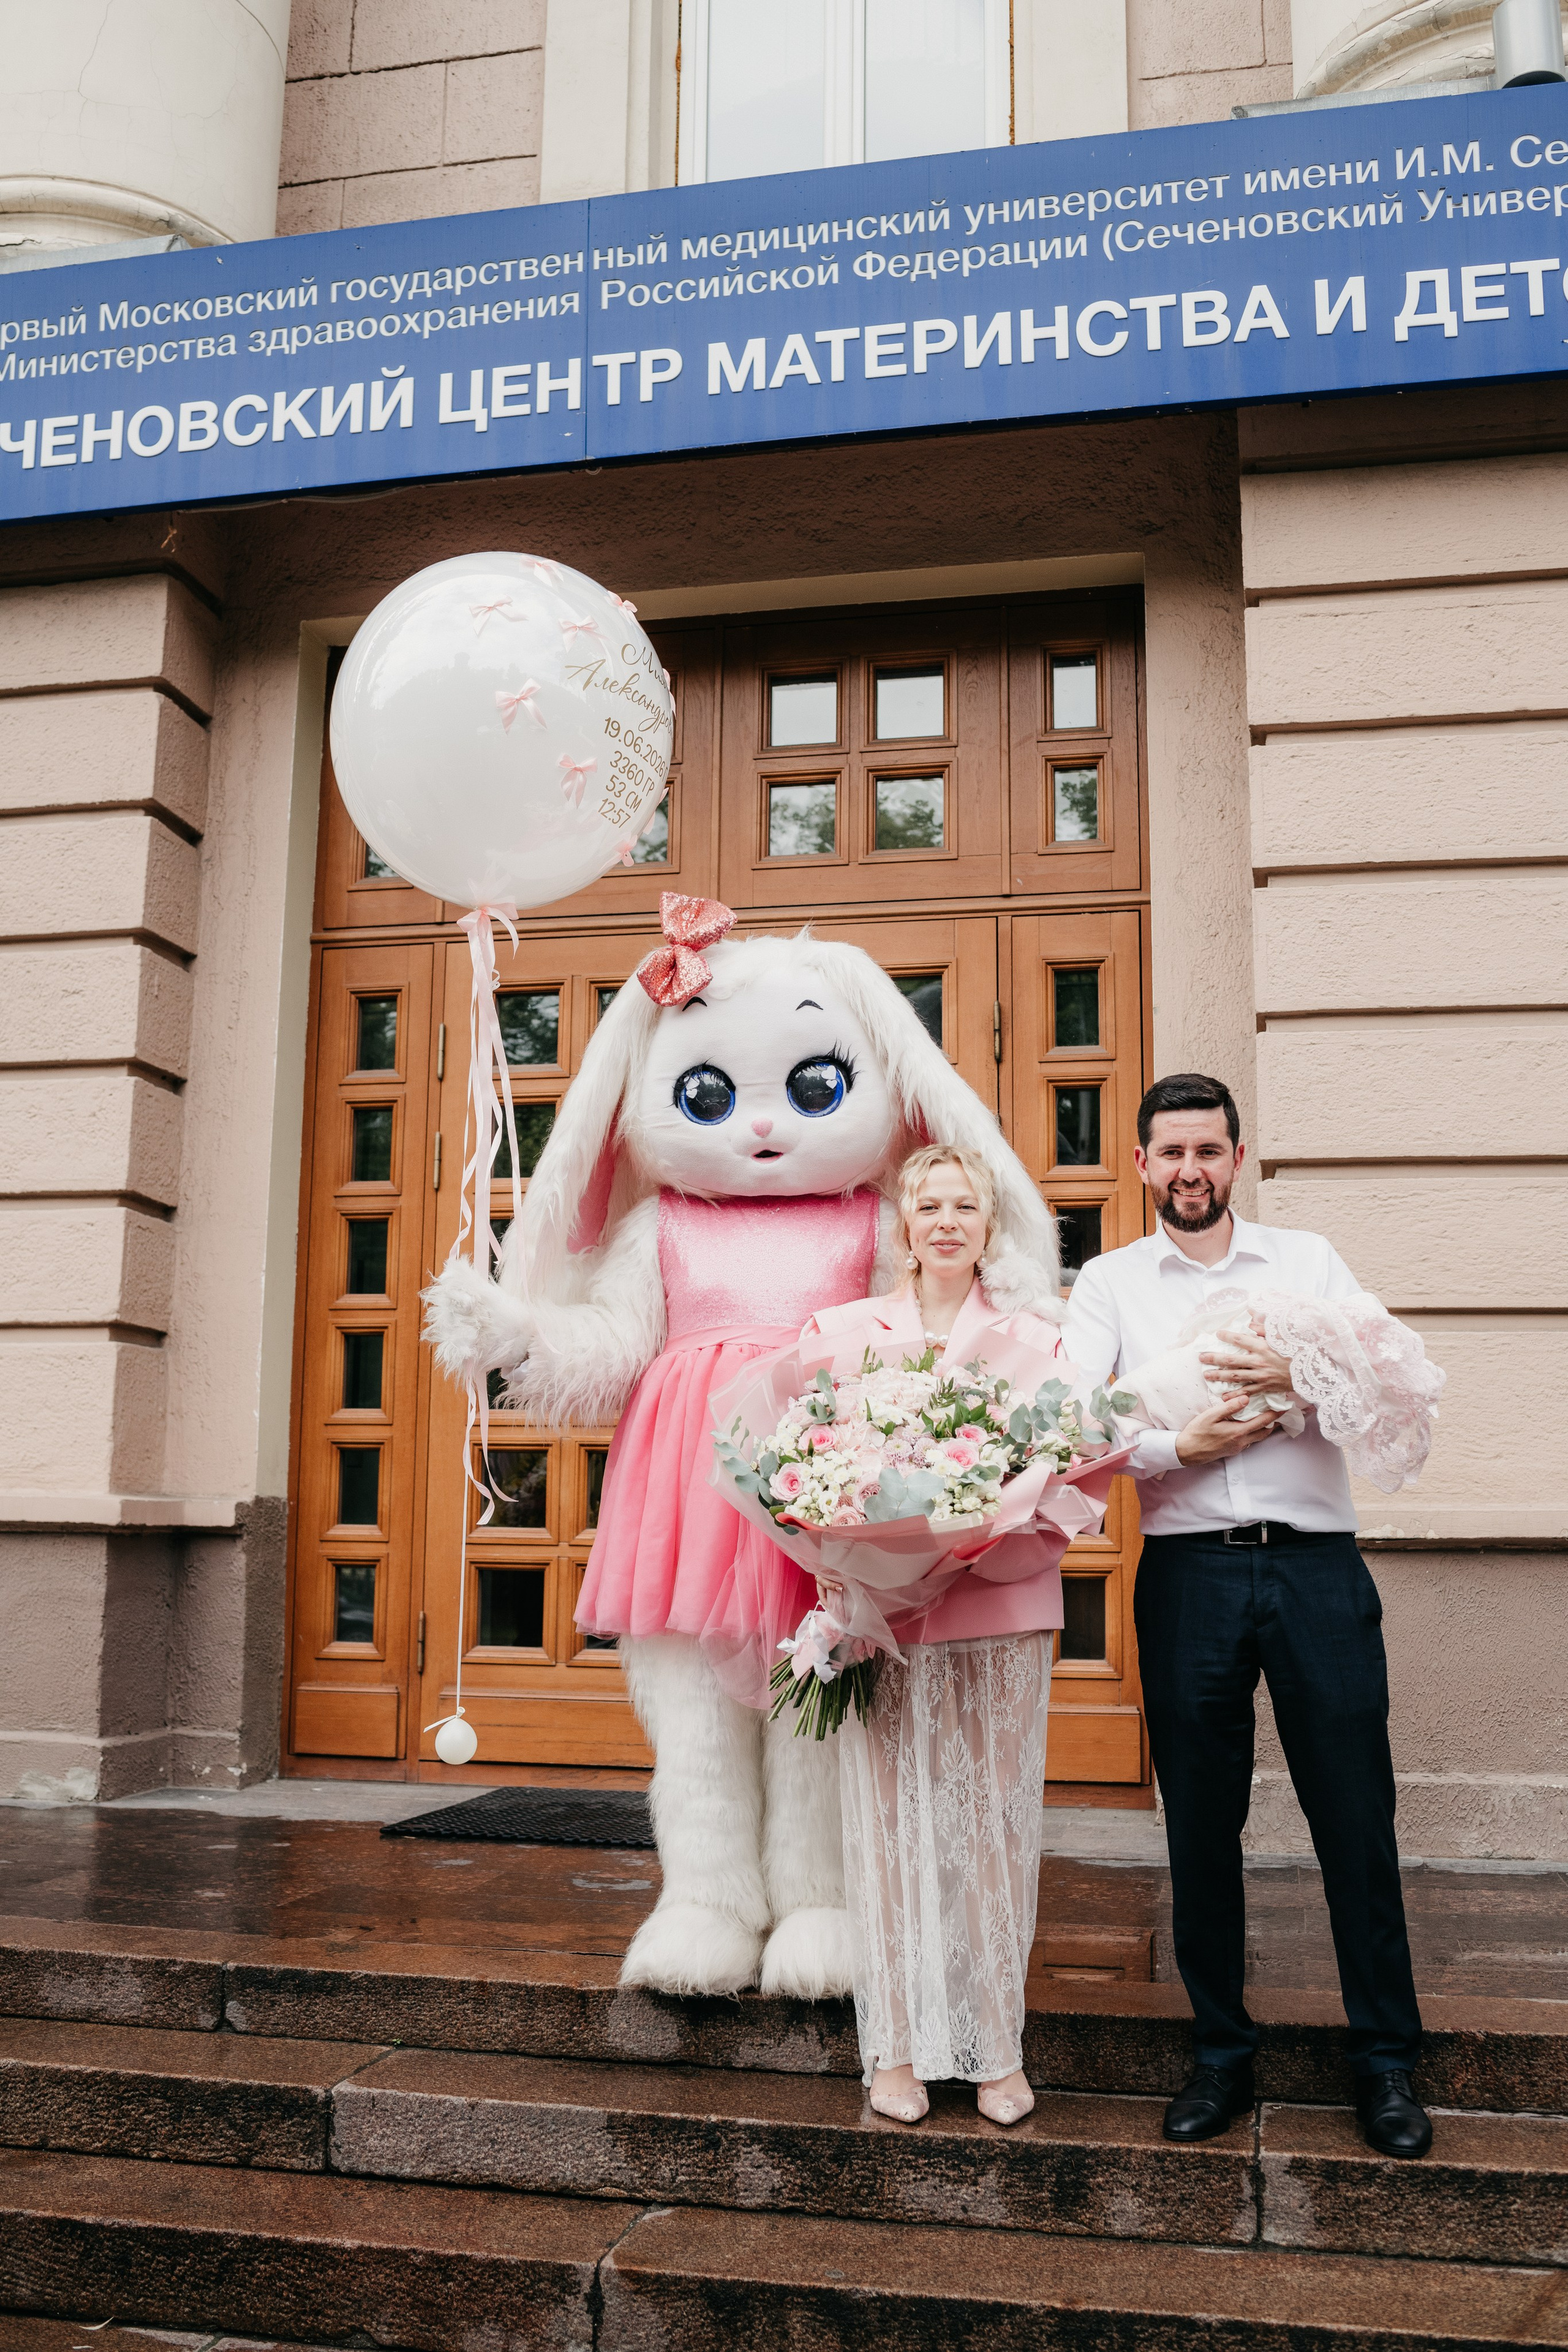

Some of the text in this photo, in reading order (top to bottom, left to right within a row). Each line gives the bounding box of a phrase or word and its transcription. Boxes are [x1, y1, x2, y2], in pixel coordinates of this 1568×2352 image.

[99, 276, 318, 332] Московский
[330, 233, 668, 304] государственный
[681, 199, 951, 262] медицинский
[963, 175, 1231, 236] университет
[1243, 159, 1379, 196] имени
[1395, 140, 1494, 180] И.М.
[247, 292, 580, 357] здравоохранения
[600, 254, 840, 311] Российской
[852, 234, 1088, 284] Федерации
[1102, 190, 1403, 262] (Сеченовский
[0, 257, 1568, 469] ЧЕНОВСКИЙ ЦЕНТР МАТЕРИНСТВА И ДЕТ
[597, 797, 631, 829] 12:57
[605, 774, 627, 799] 53
[609, 750, 644, 786] 3360
